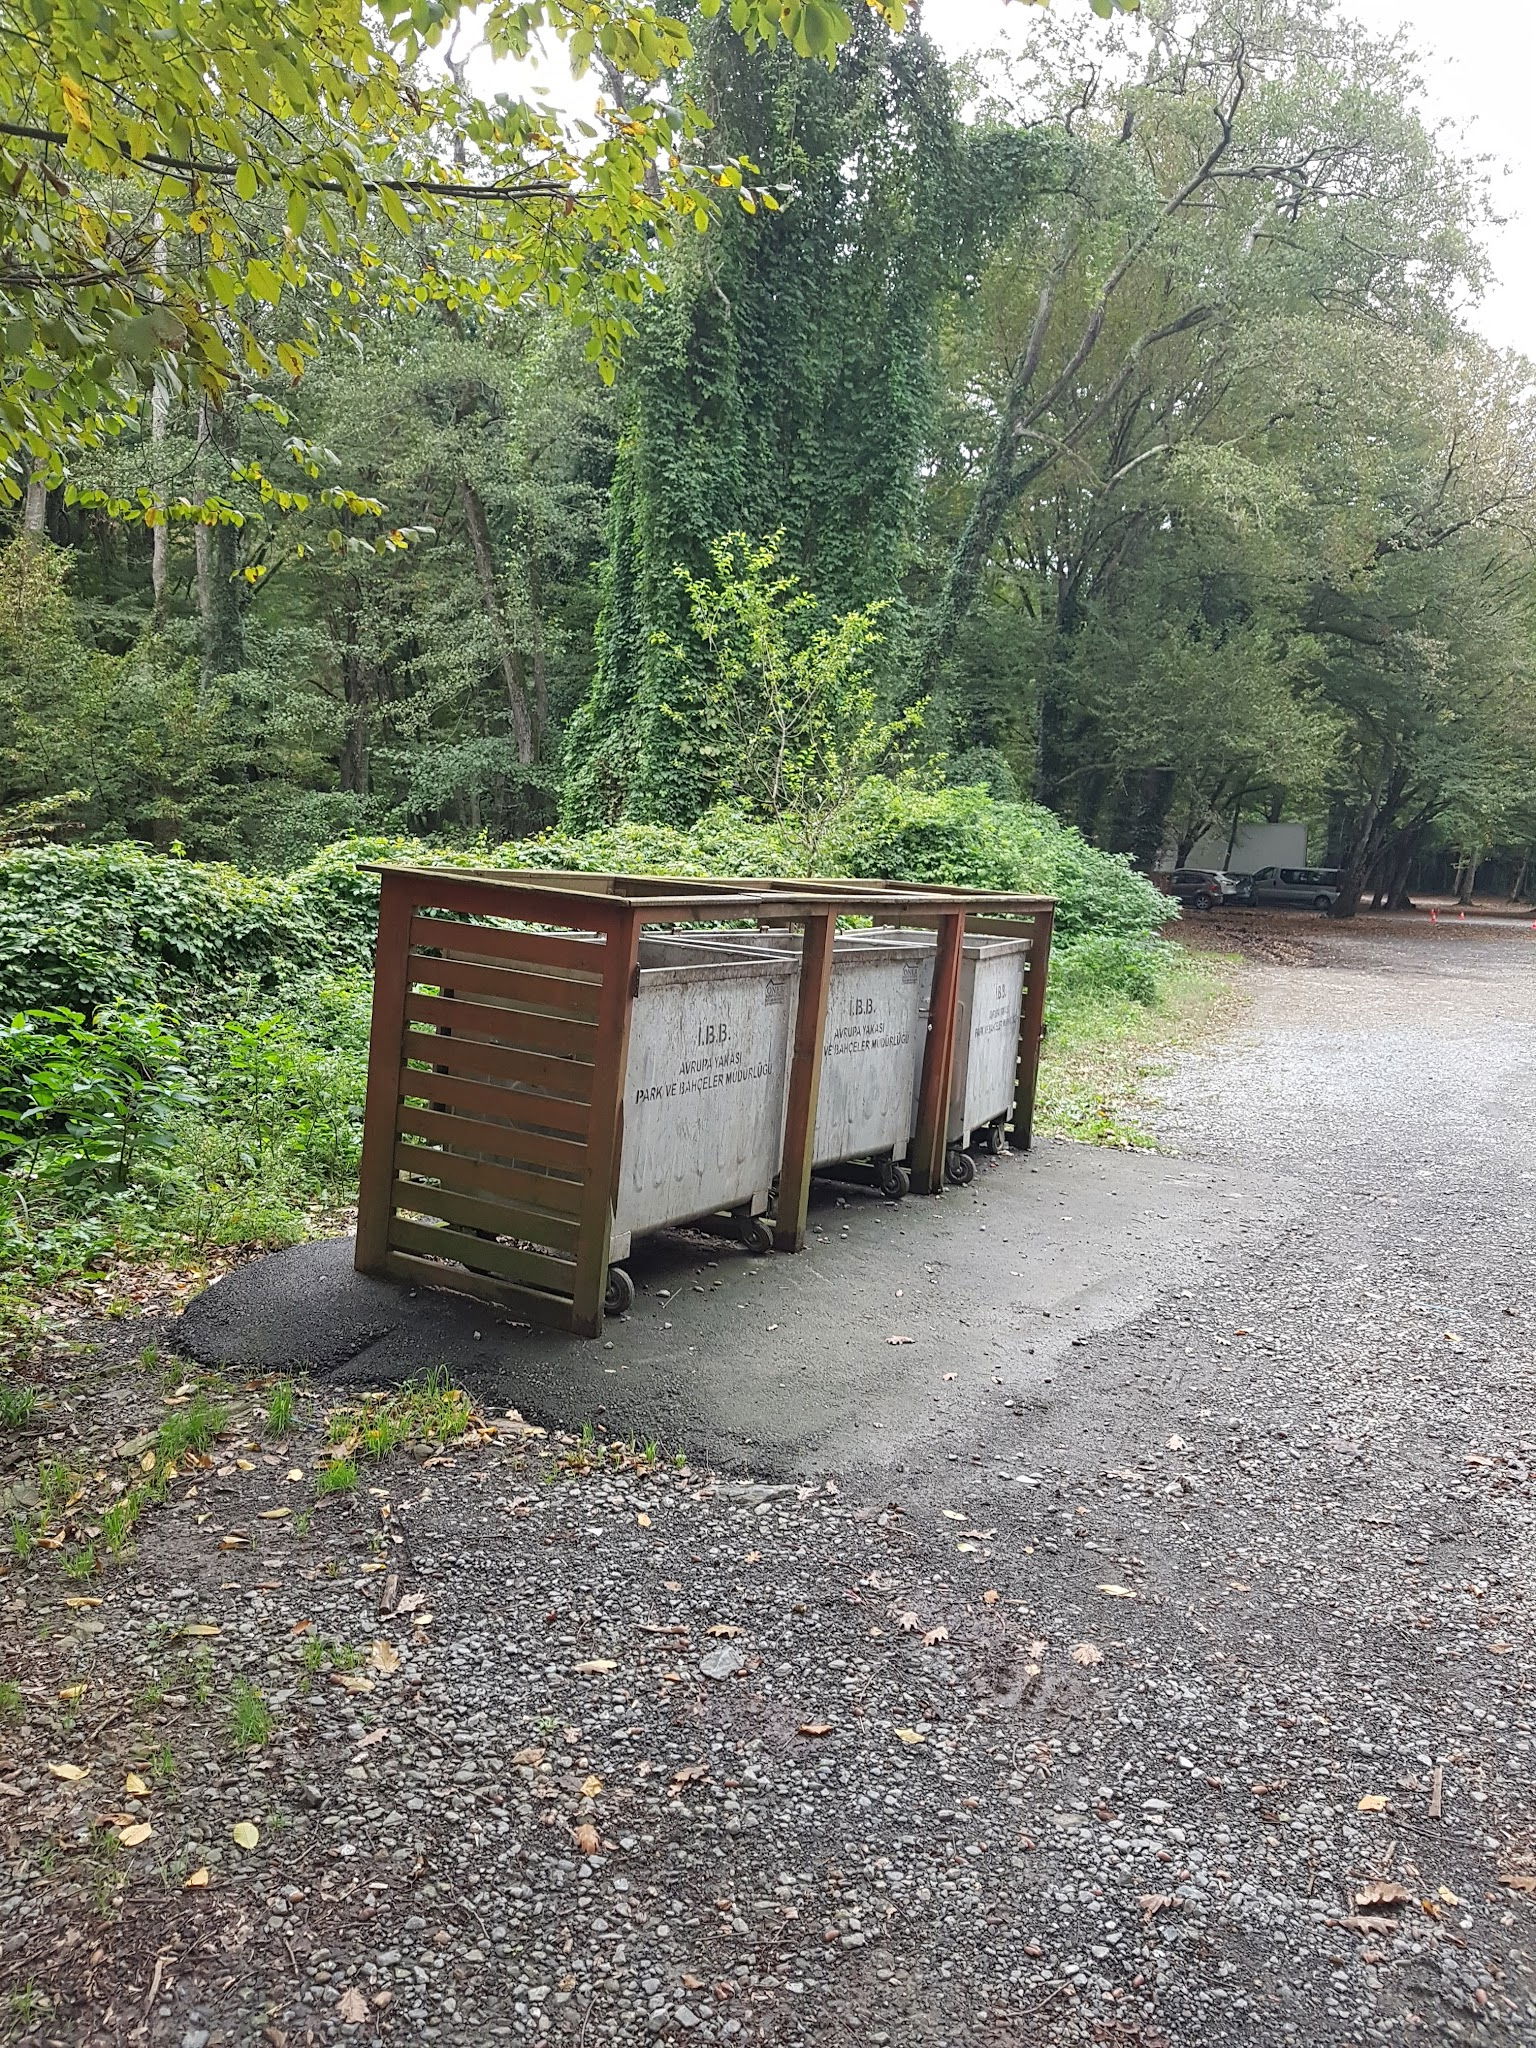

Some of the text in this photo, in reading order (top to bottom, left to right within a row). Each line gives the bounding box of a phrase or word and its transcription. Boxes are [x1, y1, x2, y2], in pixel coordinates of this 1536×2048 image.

[834, 1026, 861, 1040] AVRUPA
[679, 1051, 742, 1075] AVRUPA YAKASI
[635, 1085, 663, 1104] PARK
[664, 1082, 677, 1097] VE
[678, 1074, 725, 1095] BAHÇELER
